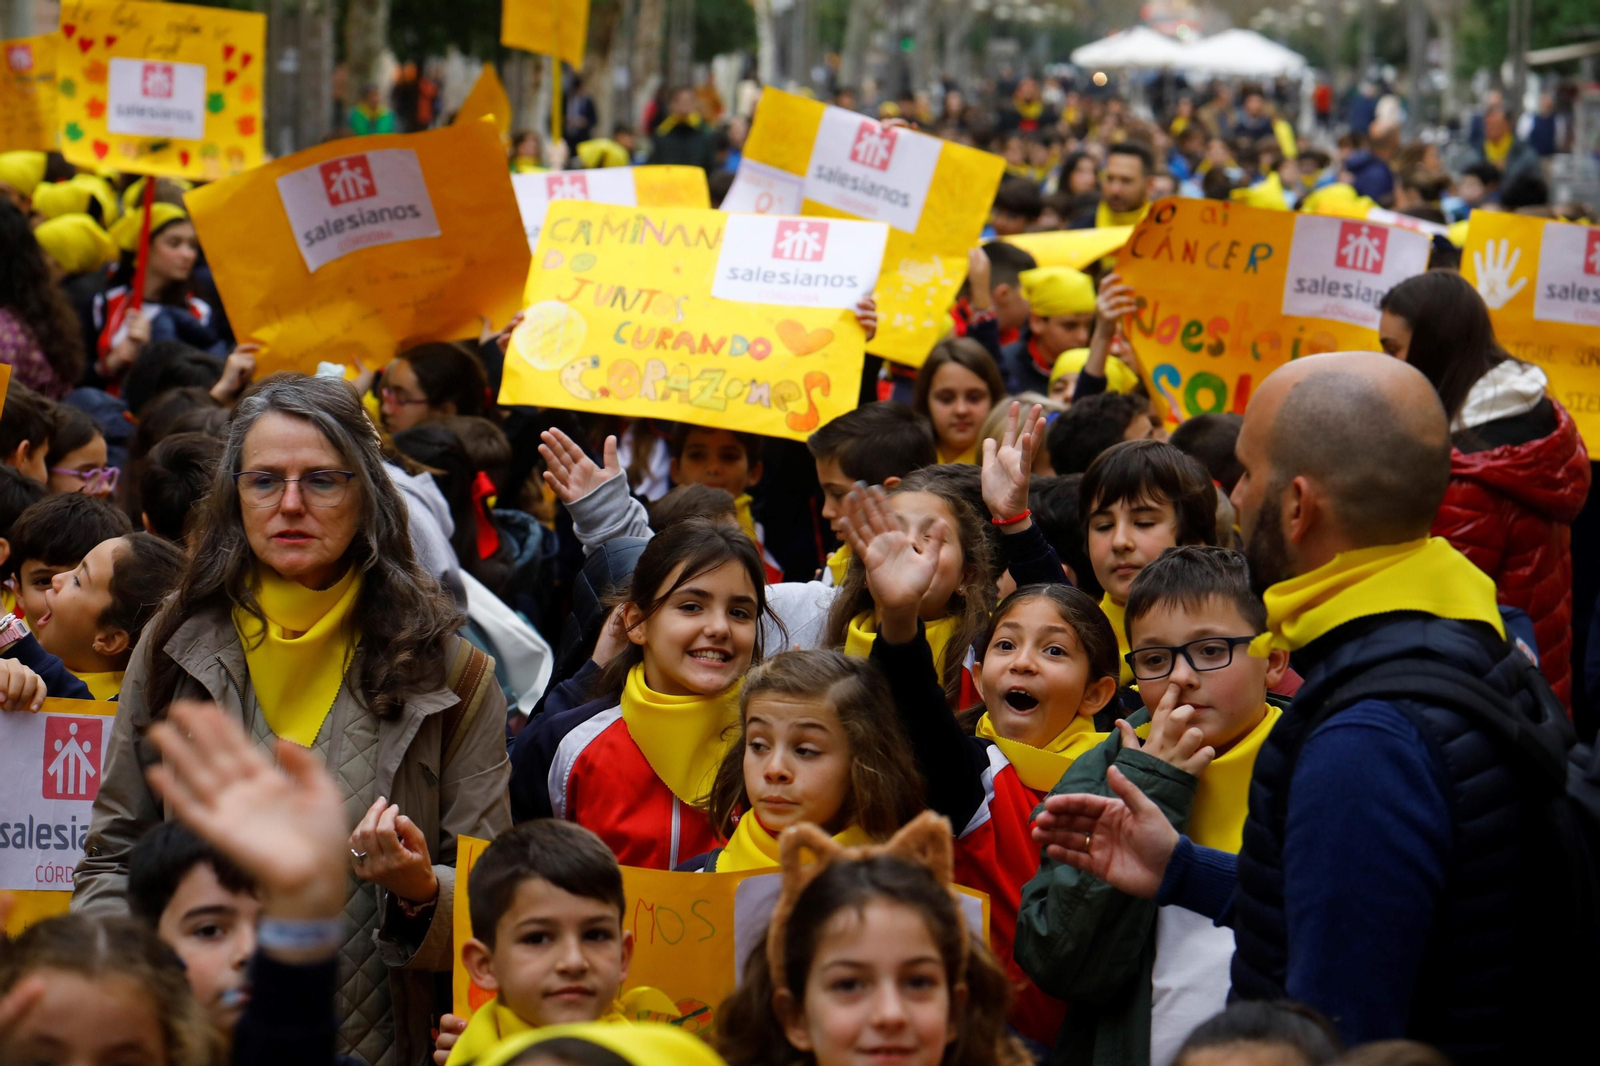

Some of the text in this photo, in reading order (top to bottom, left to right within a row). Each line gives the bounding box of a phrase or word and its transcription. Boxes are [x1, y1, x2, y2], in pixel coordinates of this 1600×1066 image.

[813, 163, 911, 208] salesianos
[303, 202, 421, 248] salesianos
[542, 248, 597, 273] DO
[726, 265, 859, 289] salesianos
[556, 276, 690, 323] JUNTOS
[613, 321, 773, 361] CURANDO
[633, 897, 716, 945] MOS
